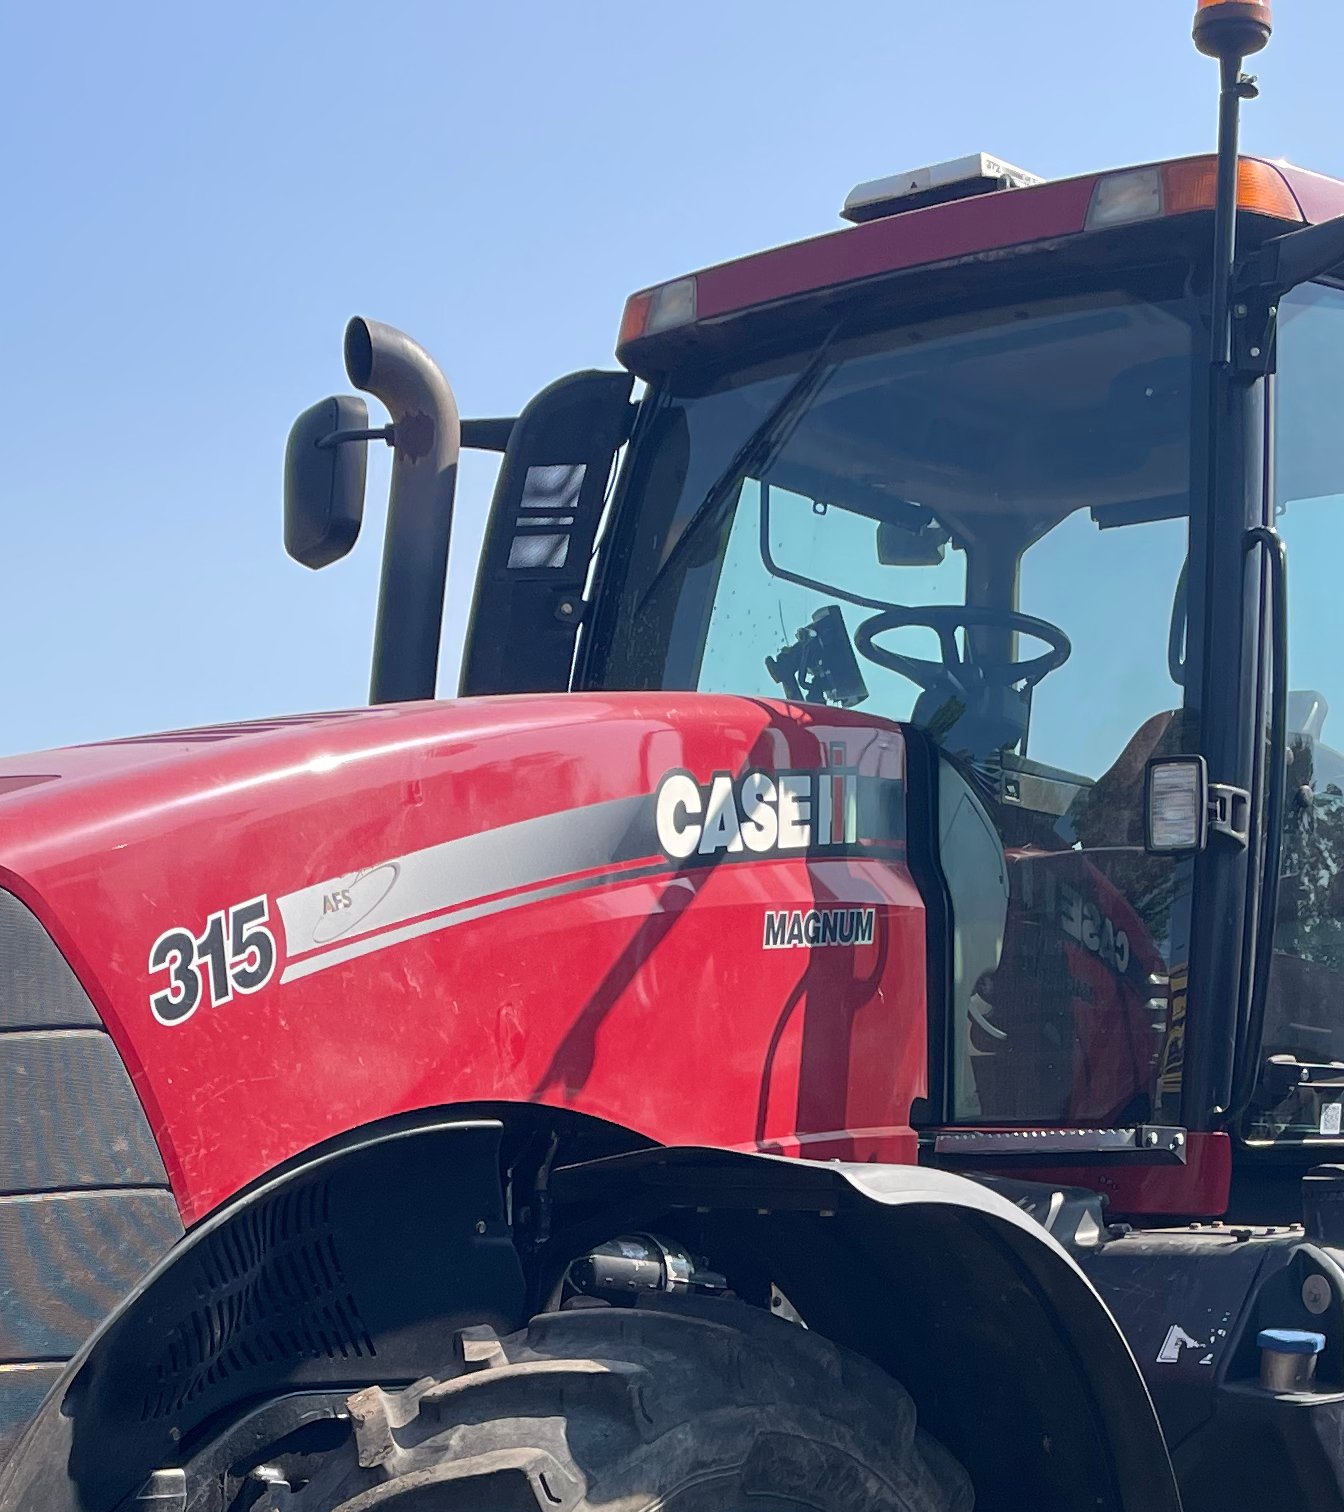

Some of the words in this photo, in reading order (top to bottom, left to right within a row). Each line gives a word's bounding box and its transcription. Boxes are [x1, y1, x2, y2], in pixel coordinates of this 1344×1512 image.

[656, 773, 812, 858] CASE
[322, 889, 353, 916] AFS
[763, 908, 876, 950] MAGNUM
[148, 893, 277, 1027] 315
